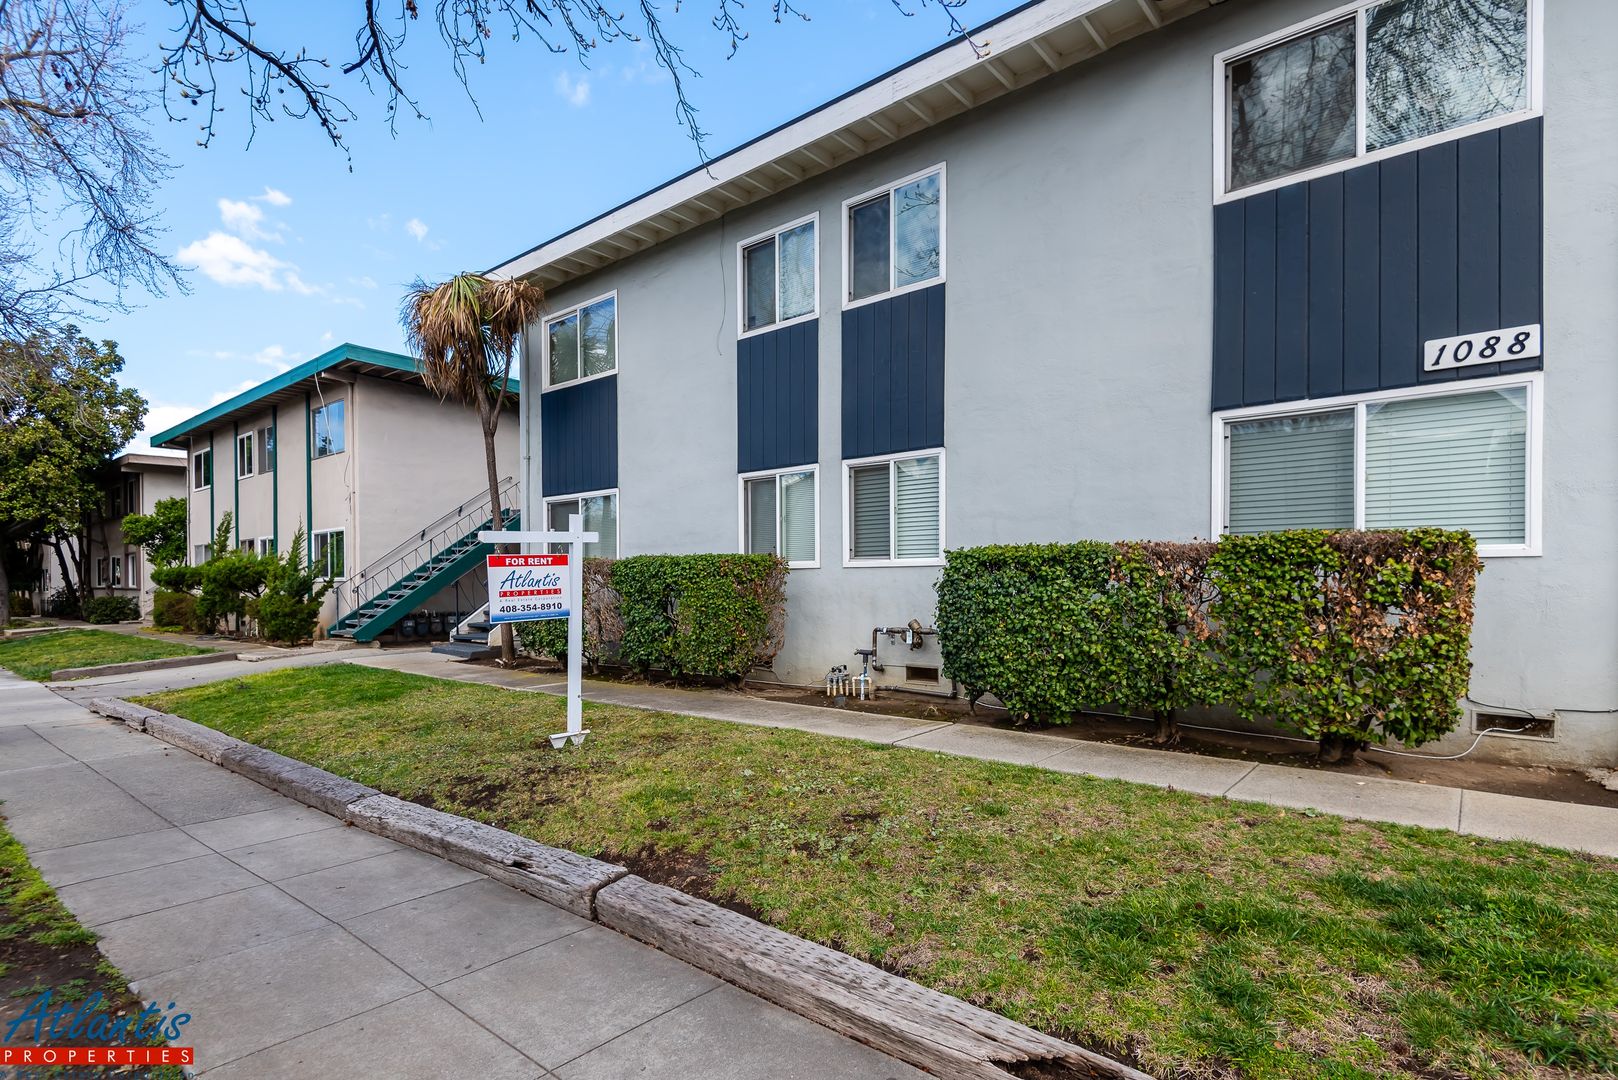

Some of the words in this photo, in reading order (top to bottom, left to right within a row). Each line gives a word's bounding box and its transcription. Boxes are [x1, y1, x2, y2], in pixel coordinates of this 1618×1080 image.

[1431, 331, 1531, 367] 1088
[505, 558, 525, 566] FOR
[528, 557, 553, 565] RENT
[500, 569, 561, 590] Atlantis
[500, 588, 561, 597] PROPERTIES
[500, 602, 562, 613] 408-354-8910
